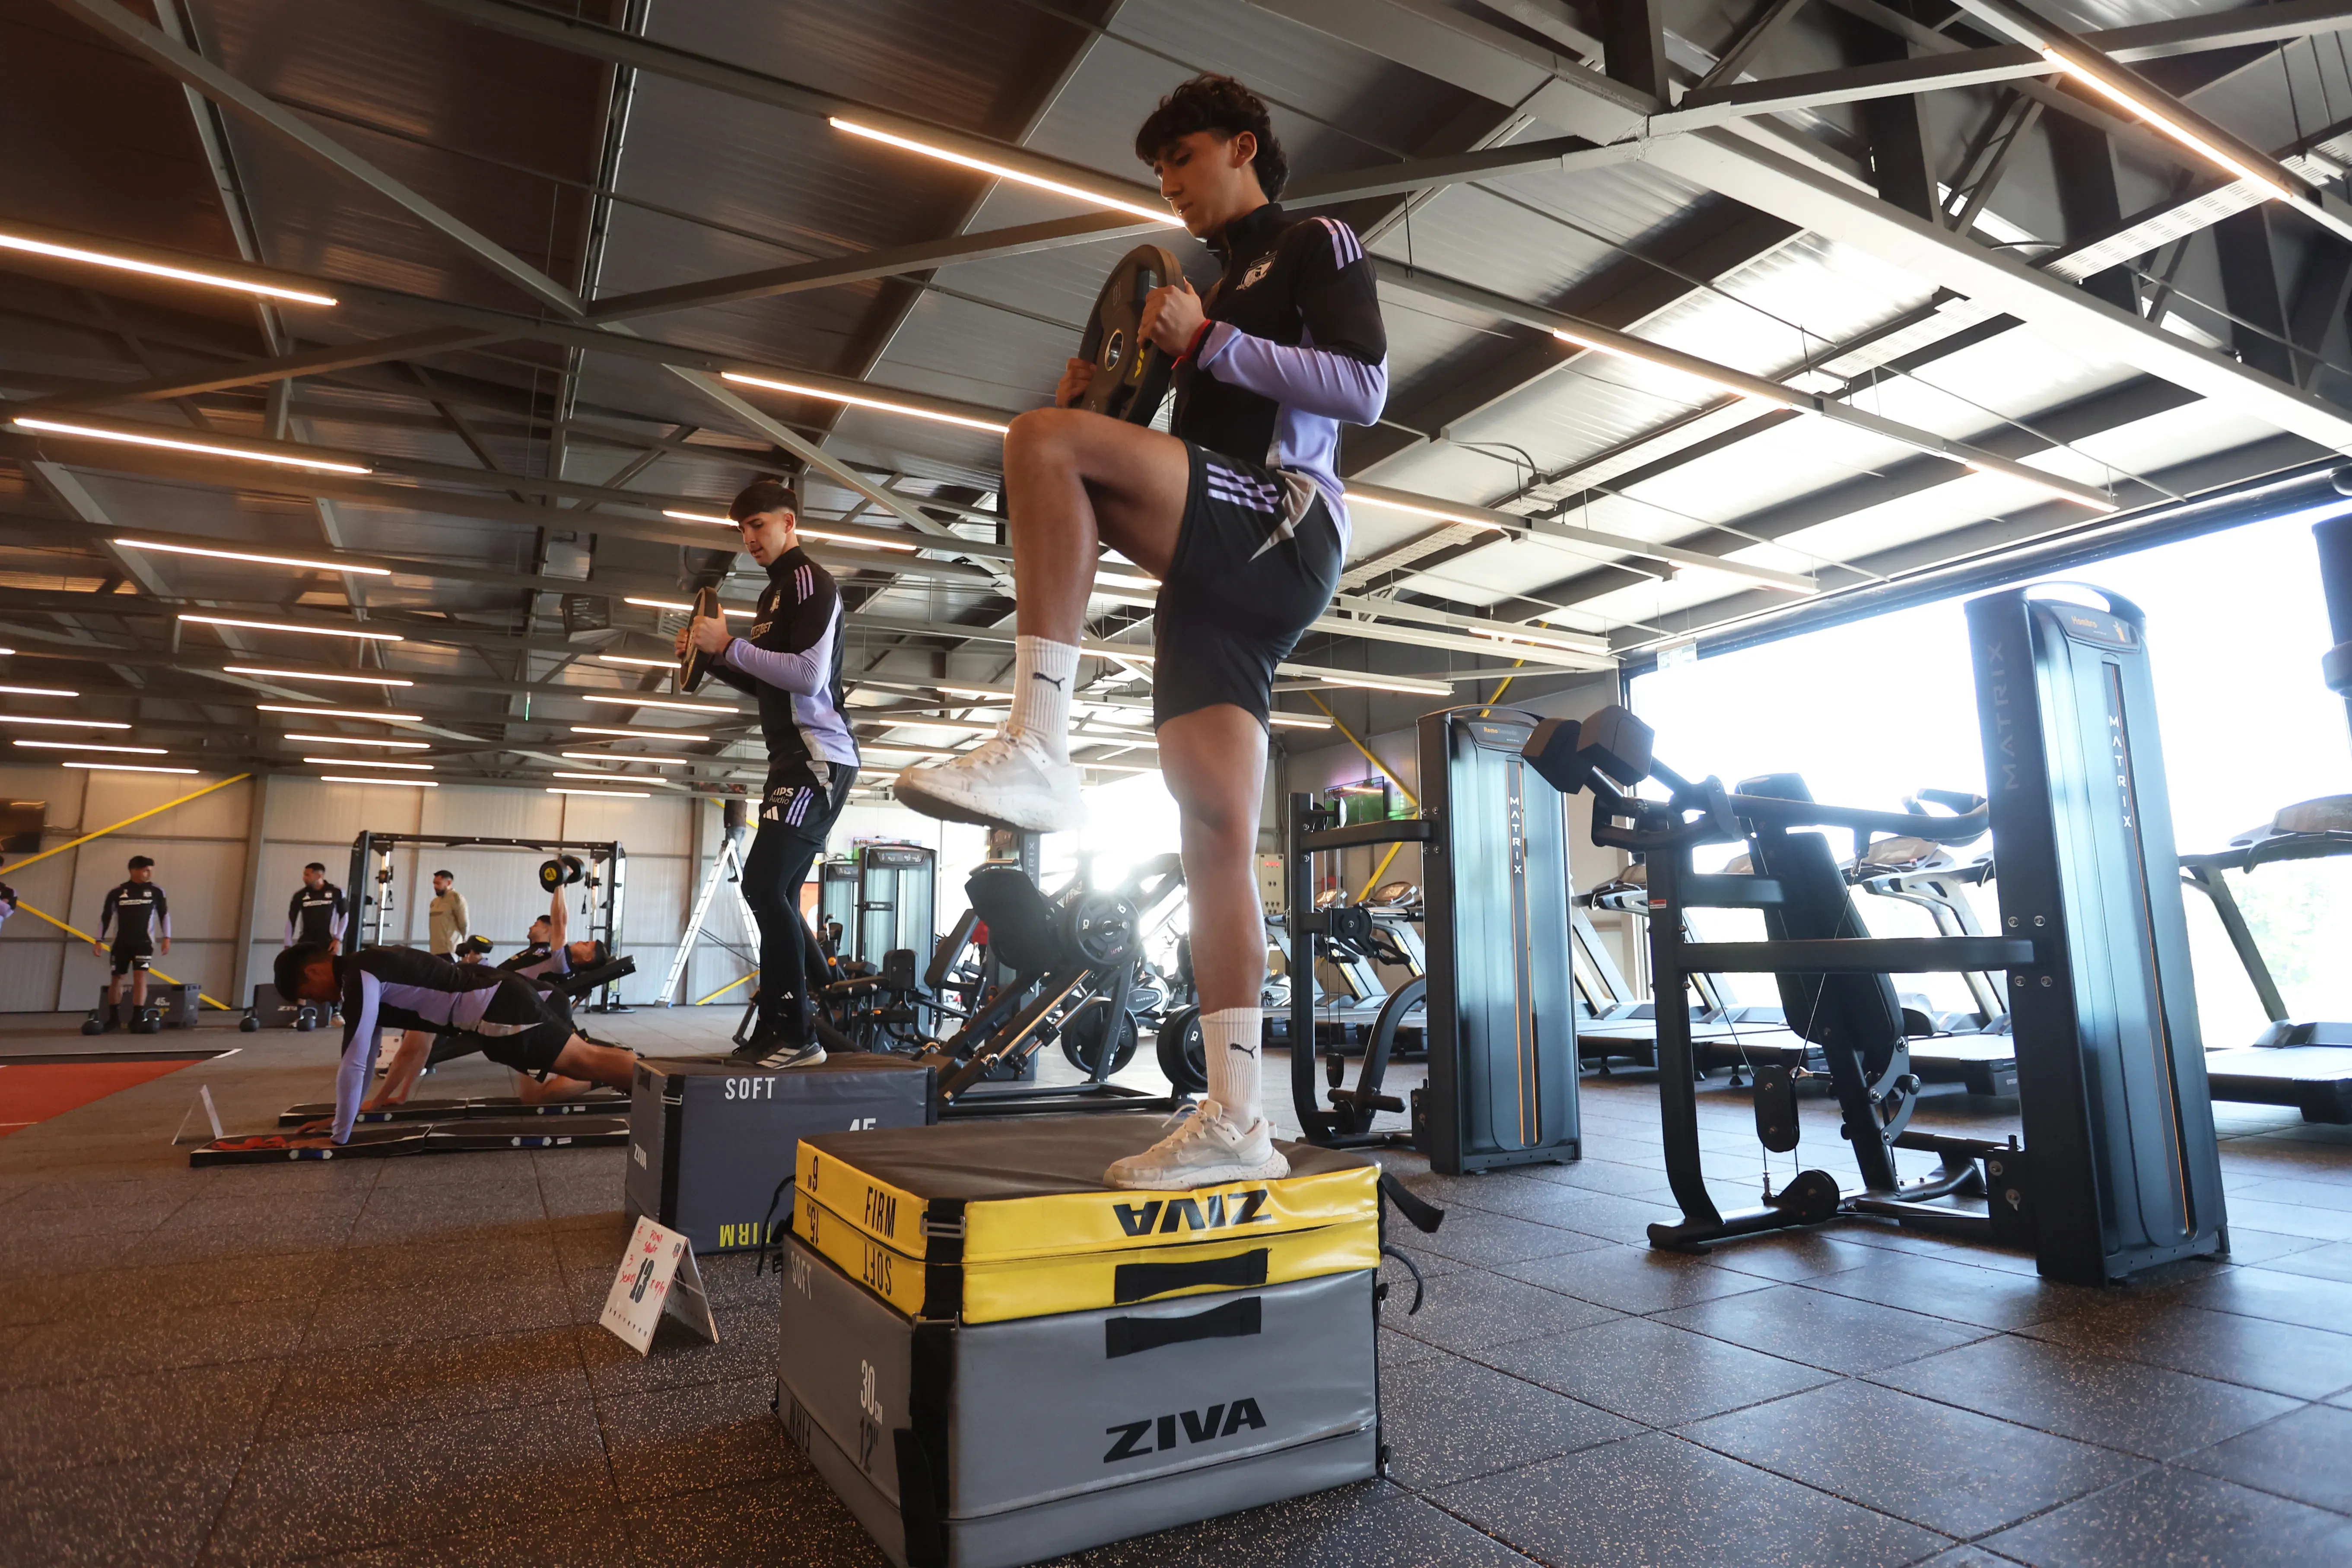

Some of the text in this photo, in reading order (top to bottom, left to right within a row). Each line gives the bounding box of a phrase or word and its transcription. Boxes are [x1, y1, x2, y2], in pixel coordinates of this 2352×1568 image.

[1990, 641, 2019, 790] MATRIX
[2108, 715, 2132, 828] MATRIX
[1510, 797, 1522, 873] MATRIX
[1083, 919, 1089, 930] 10
[1117, 903, 1126, 914] 10
[1191, 1031, 1198, 1041] 10
[725, 1077, 775, 1100] SOFT
[634, 1143, 646, 1170] ZIVA
[865, 1186, 896, 1239] FIRM
[1112, 1189, 1271, 1237] ZIVA
[629, 1257, 654, 1304] 13
[791, 1251, 811, 1300] SOFT
[863, 1243, 891, 1296] SOFT
[789, 1397, 810, 1455] FIRM
[1104, 1397, 1266, 1463] ZIVA
